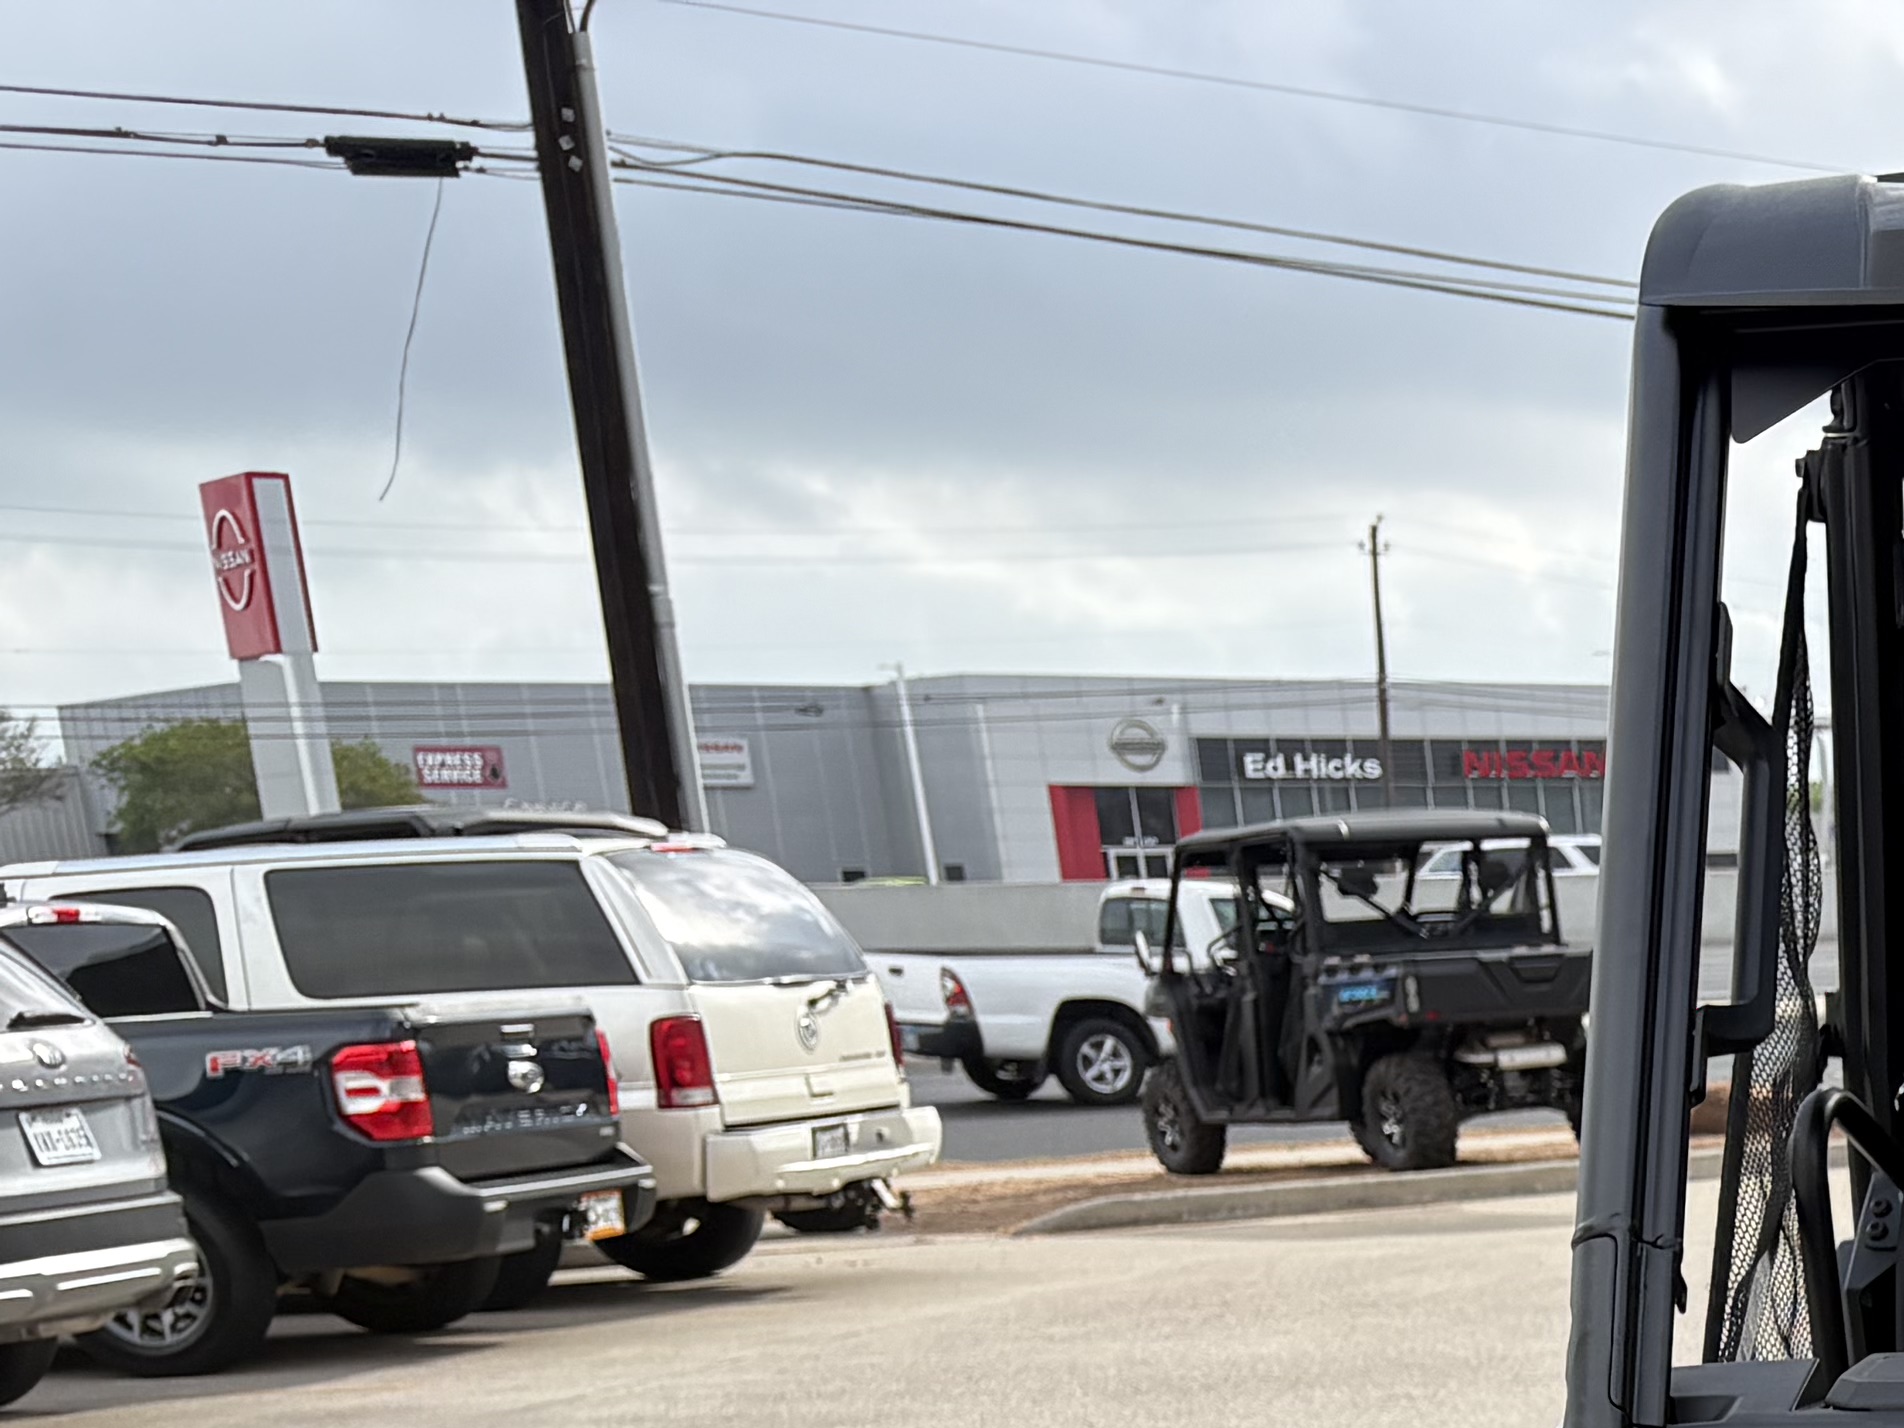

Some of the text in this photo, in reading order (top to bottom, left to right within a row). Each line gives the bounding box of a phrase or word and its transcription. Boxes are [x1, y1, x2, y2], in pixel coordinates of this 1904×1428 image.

[417, 752, 483, 767] EXPRESS
[1243, 752, 1383, 779] Ed Hicks
[1464, 750, 1606, 778] NISSAN
[422, 769, 483, 783] SERVICE
